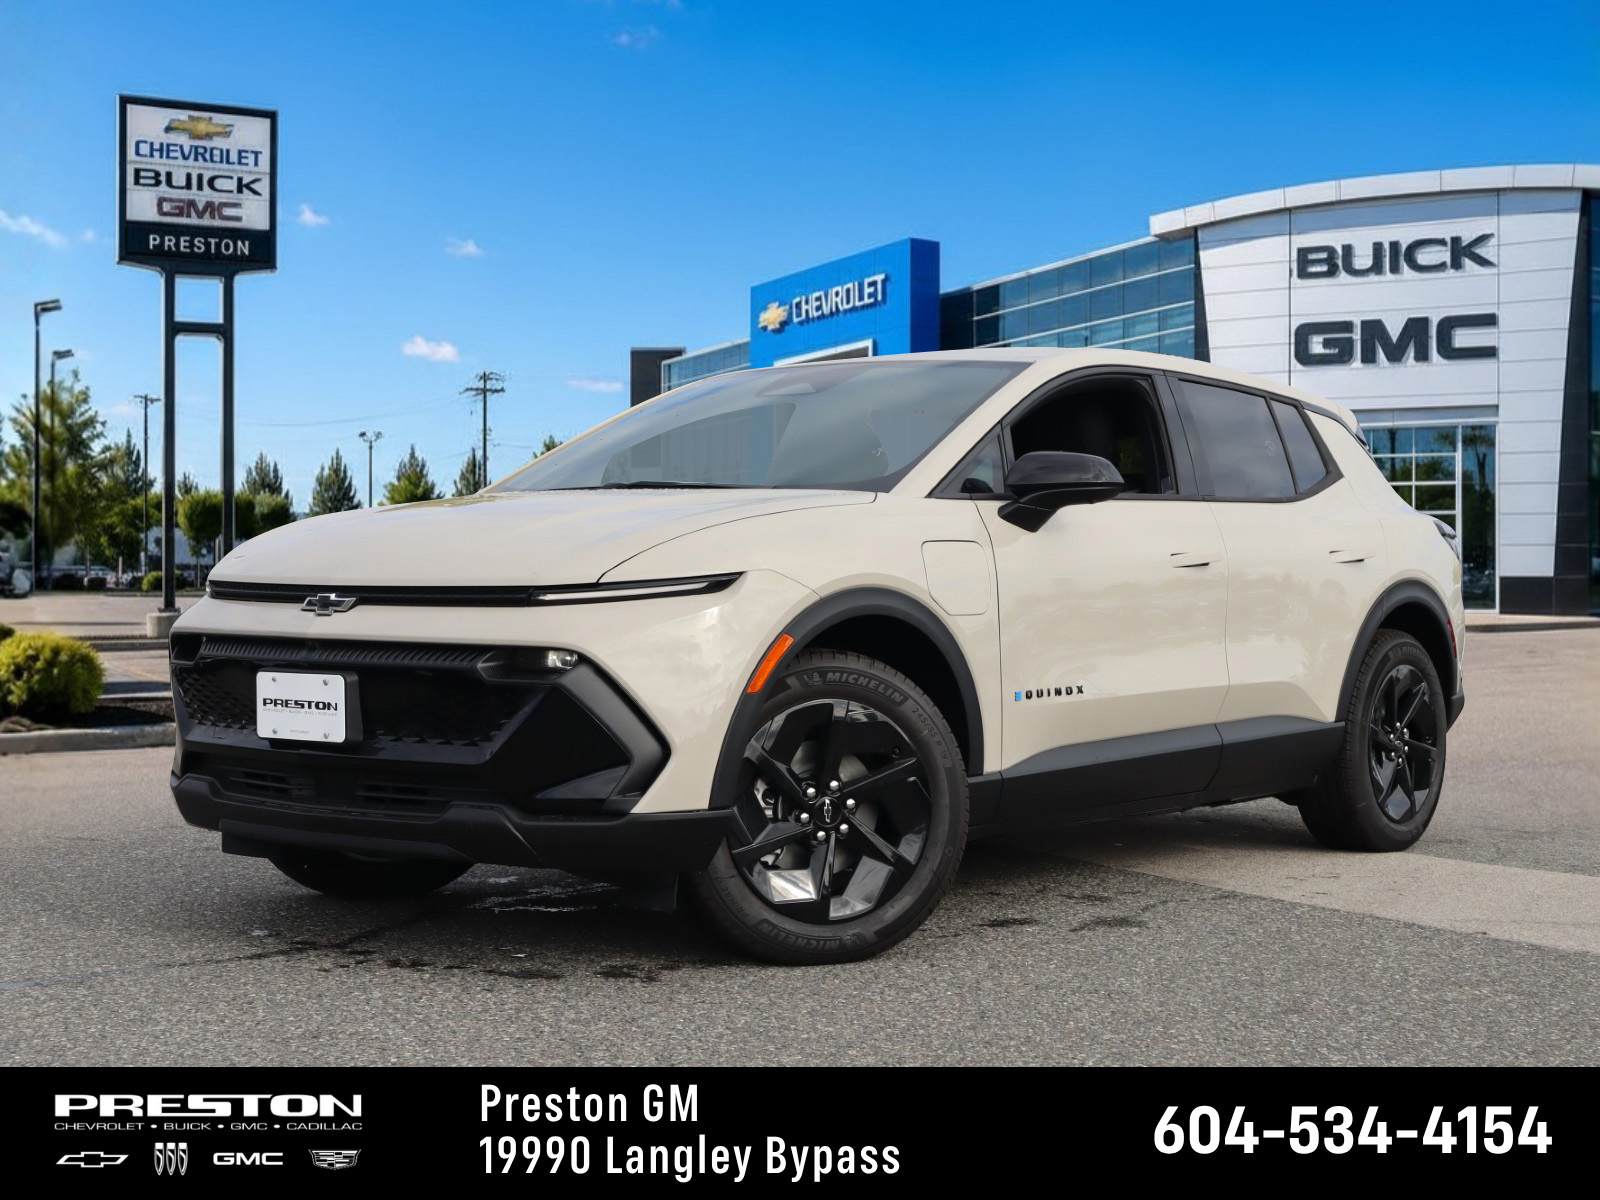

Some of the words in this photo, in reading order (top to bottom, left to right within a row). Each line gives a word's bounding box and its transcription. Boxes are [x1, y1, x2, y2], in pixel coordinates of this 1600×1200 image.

[134, 139, 263, 167] CHEVROLET
[133, 167, 263, 197] BUICK
[156, 196, 243, 222] GMC
[149, 234, 250, 256] PRESTON
[1296, 233, 1498, 280] BUICK
[792, 273, 887, 323] CHEVROLET
[1294, 312, 1498, 367] GMC
[825, 671, 905, 704] MICHELIN
[1014, 685, 1084, 702] EQUINOX
[262, 697, 338, 712] PRESTON
[756, 922, 841, 951] MICHELIN
